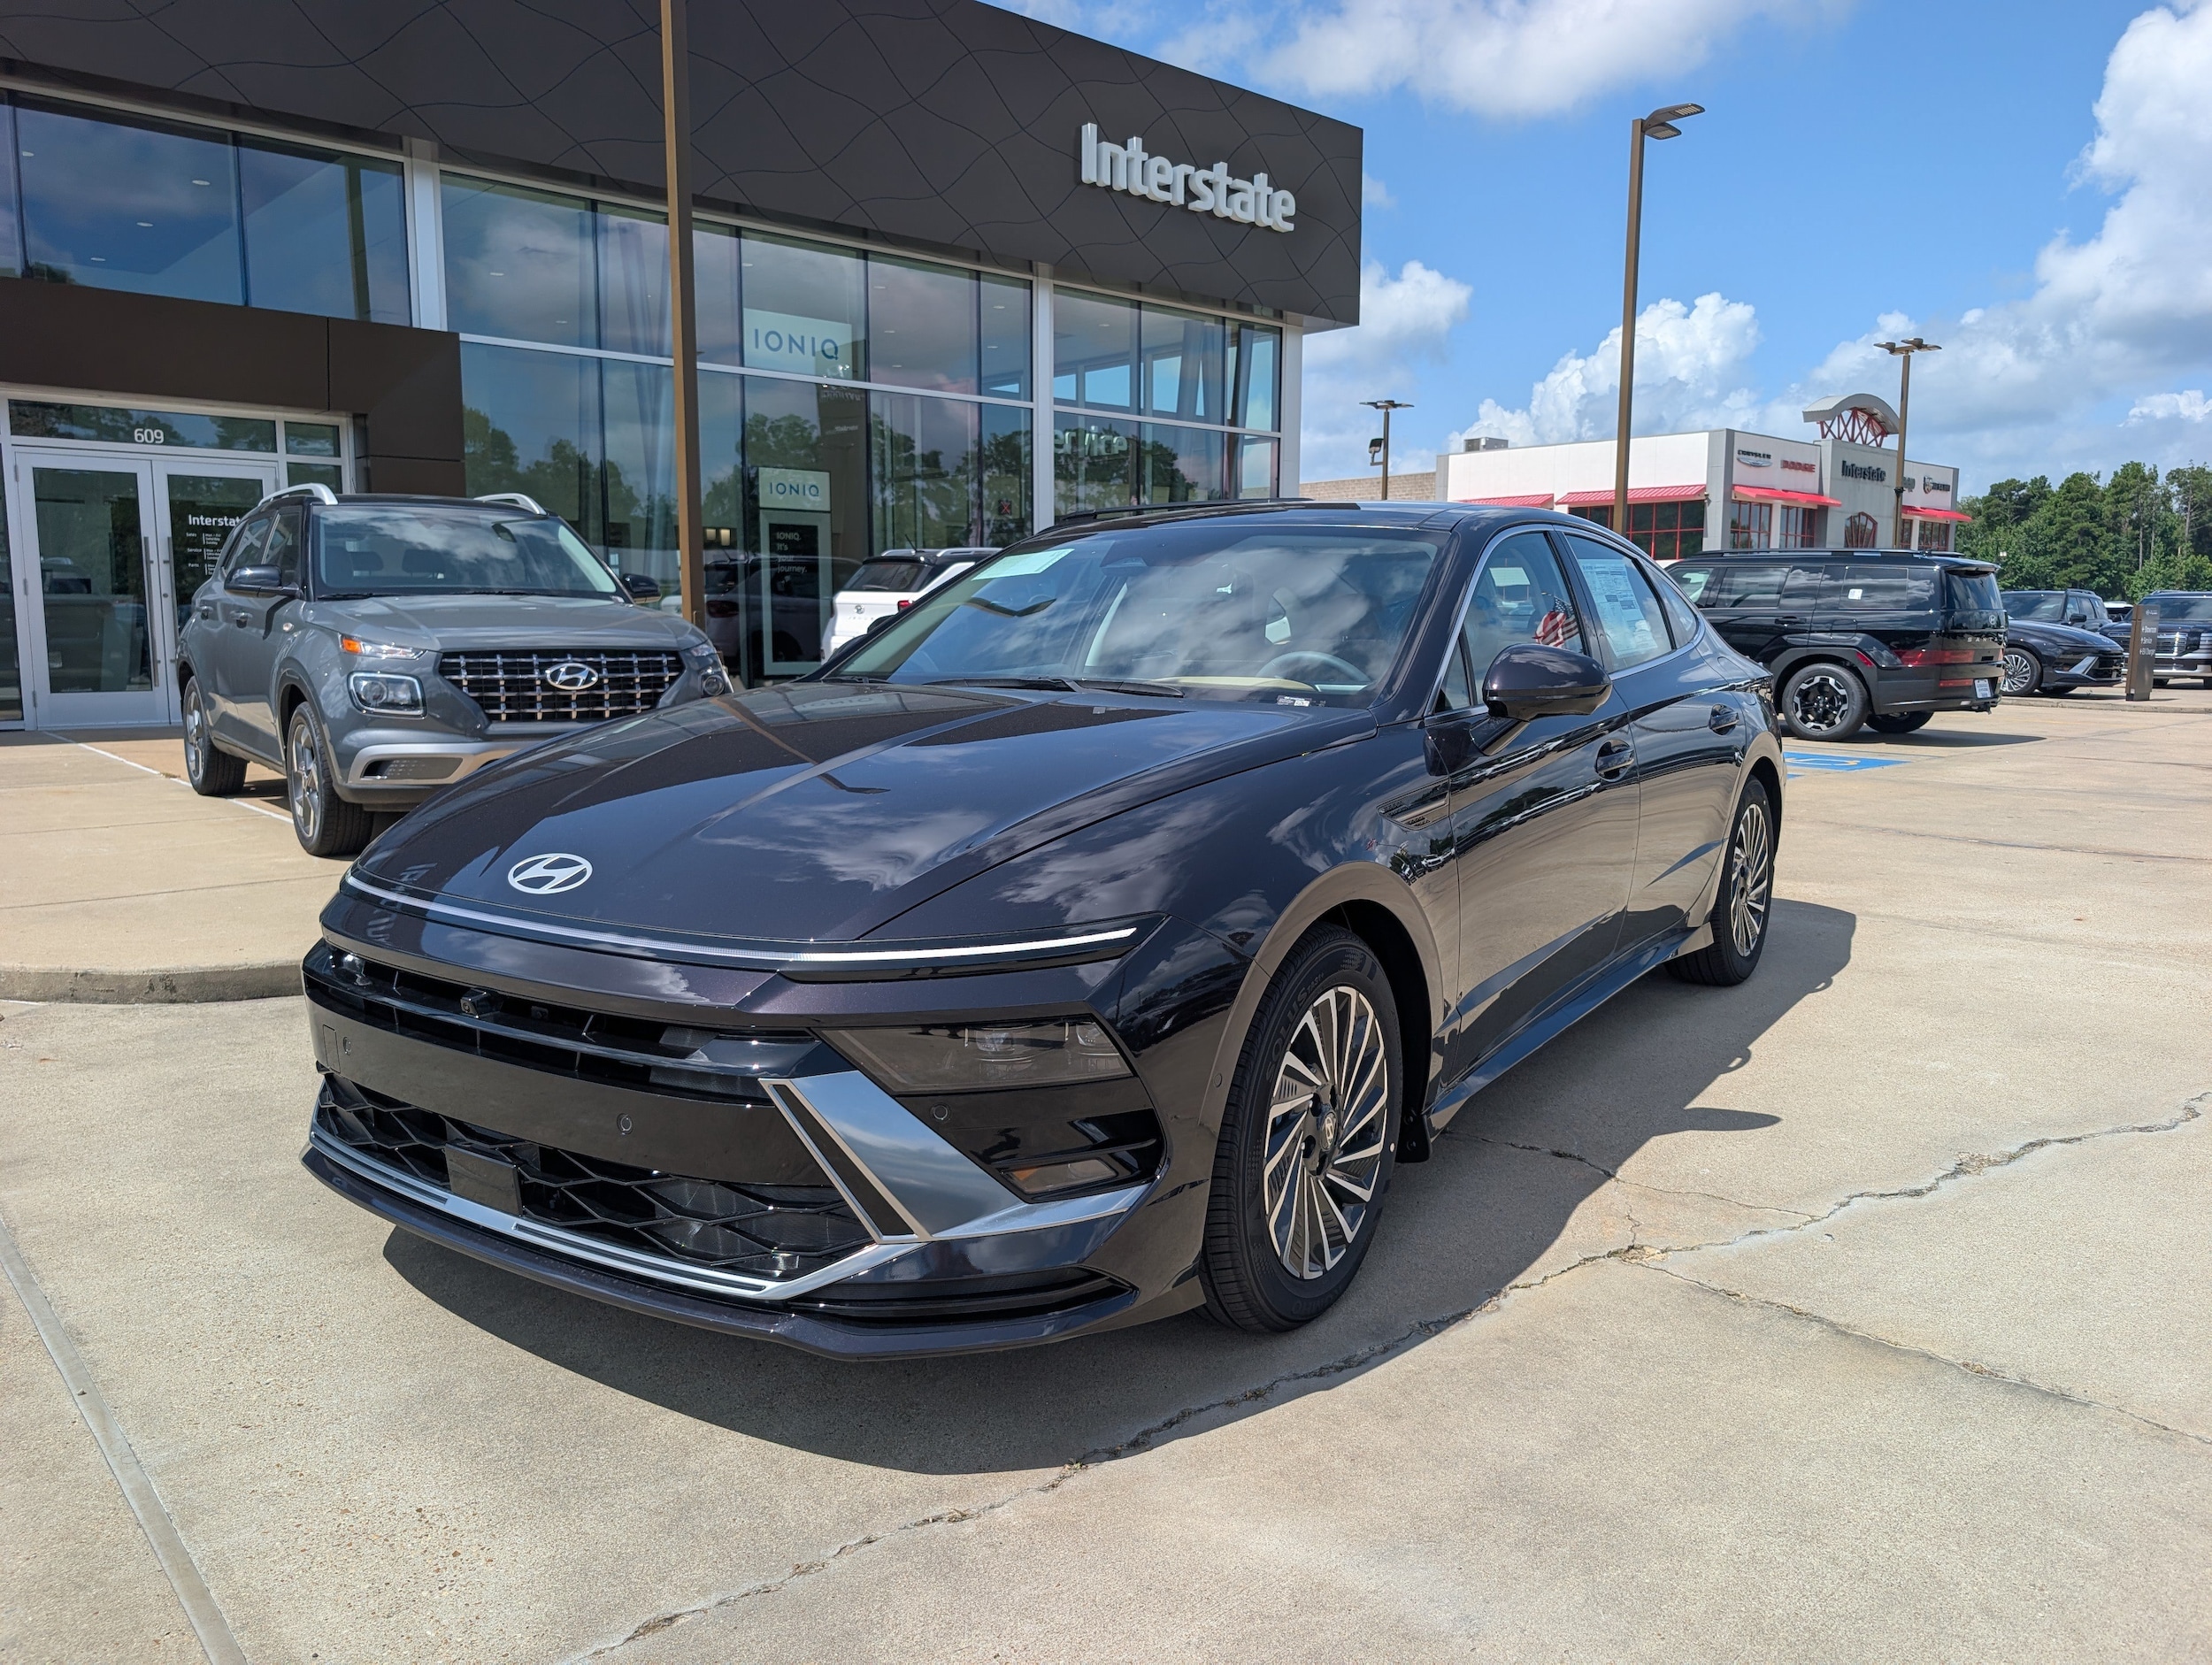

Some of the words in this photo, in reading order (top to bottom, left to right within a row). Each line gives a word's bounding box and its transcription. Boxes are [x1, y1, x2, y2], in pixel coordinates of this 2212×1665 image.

[1081, 122, 1295, 233] Interstate
[754, 328, 839, 361] IONIQ
[134, 428, 165, 444] 609
[1053, 425, 1128, 457] ervice
[1737, 449, 1771, 459] CHRYSLER
[1780, 459, 1816, 472] DODGE
[1841, 459, 1886, 483] Interstate
[769, 482, 819, 497] IONIQ
[188, 514, 242, 527] Interstat
